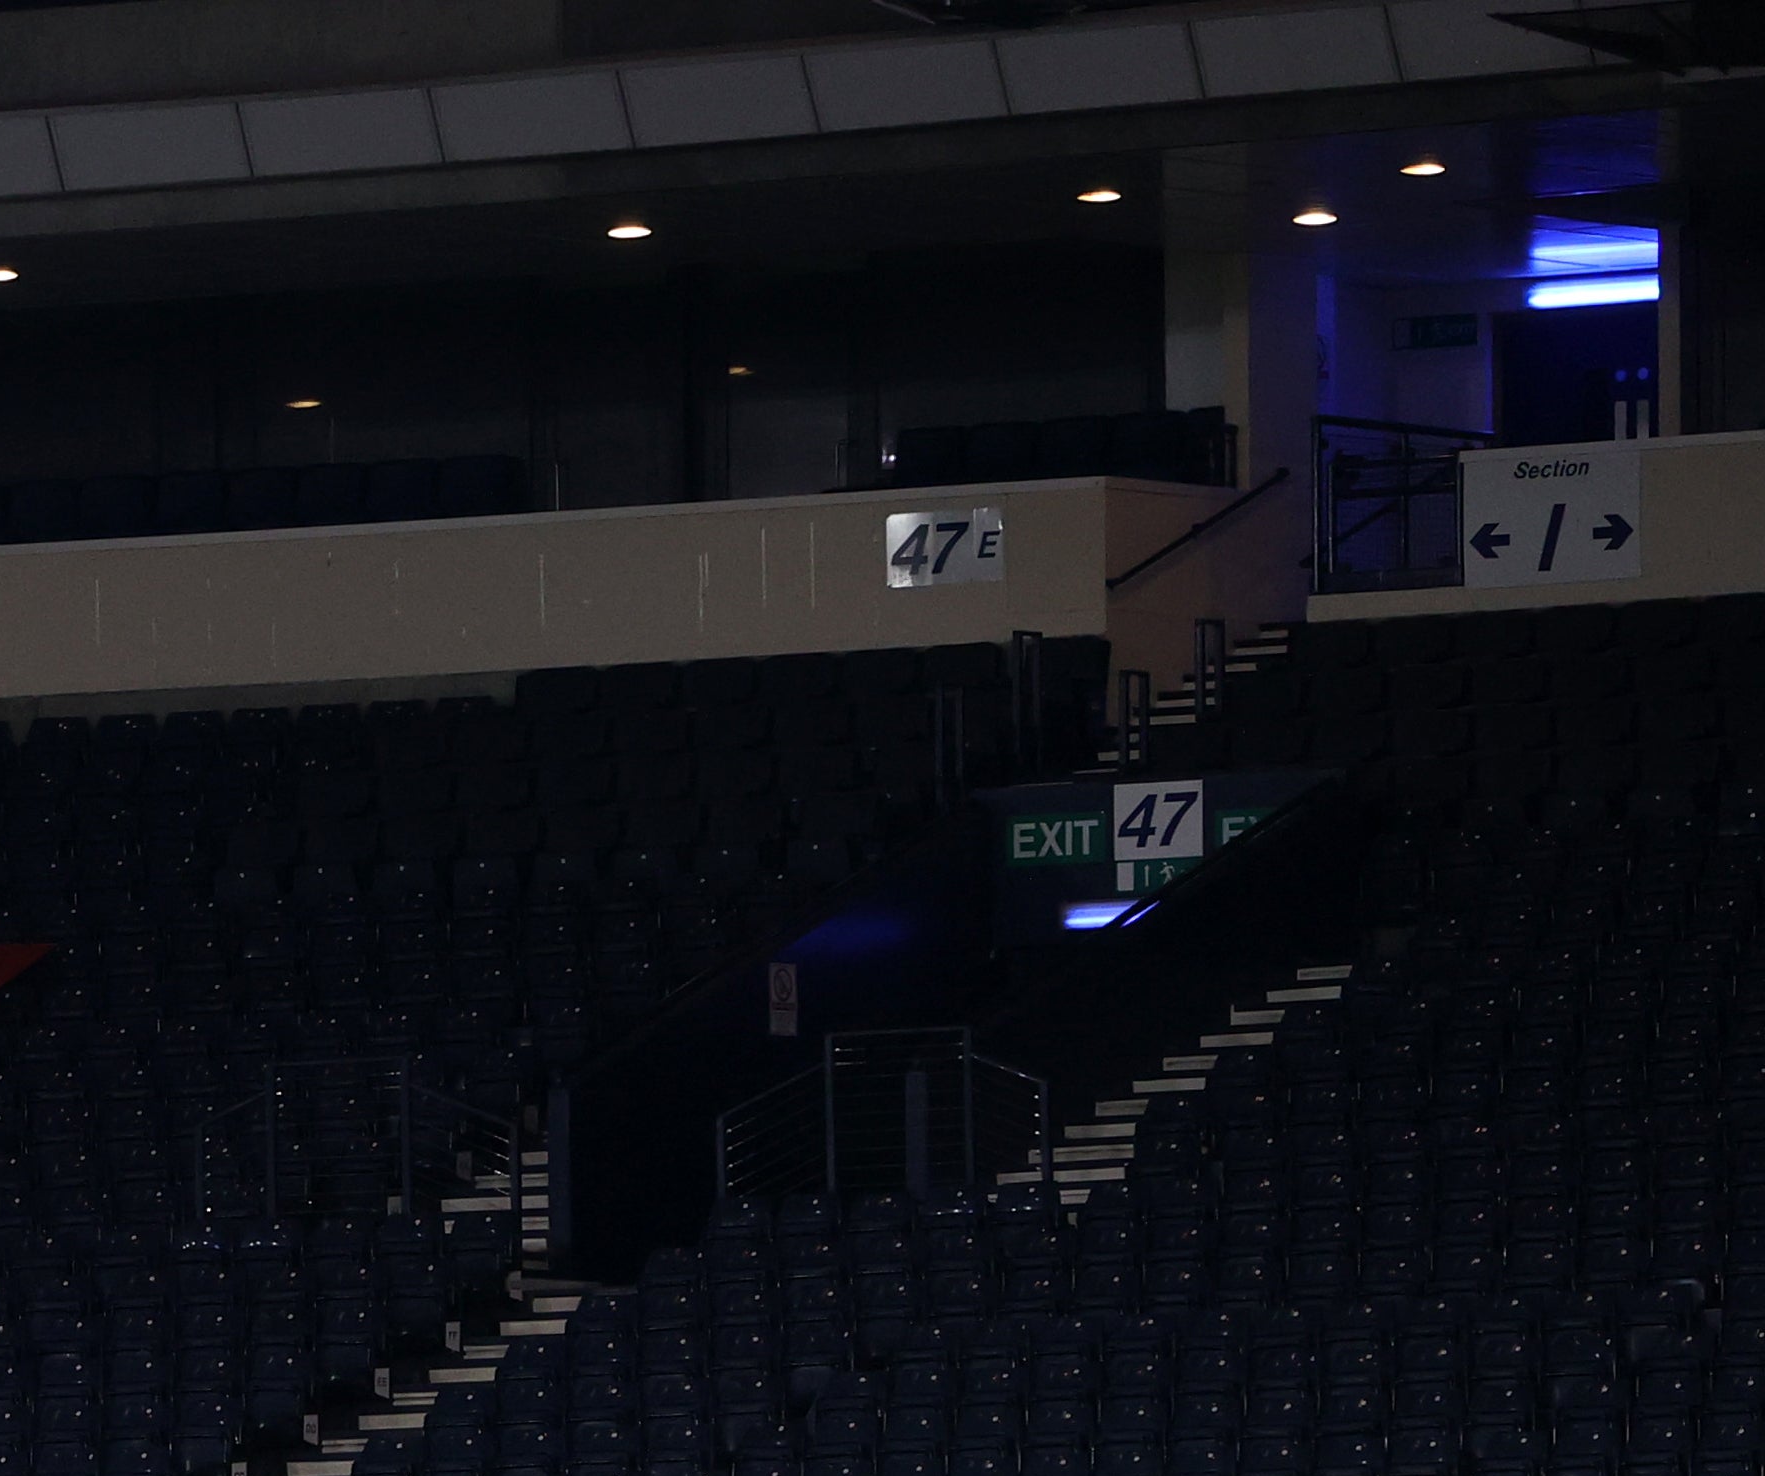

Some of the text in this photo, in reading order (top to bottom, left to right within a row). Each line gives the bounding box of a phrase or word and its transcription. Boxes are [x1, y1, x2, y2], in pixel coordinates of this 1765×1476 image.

[1512, 459, 1591, 480] Section
[891, 521, 1002, 576] 47 E
[1012, 818, 1100, 860] EXIT
[1117, 790, 1200, 849] 47
